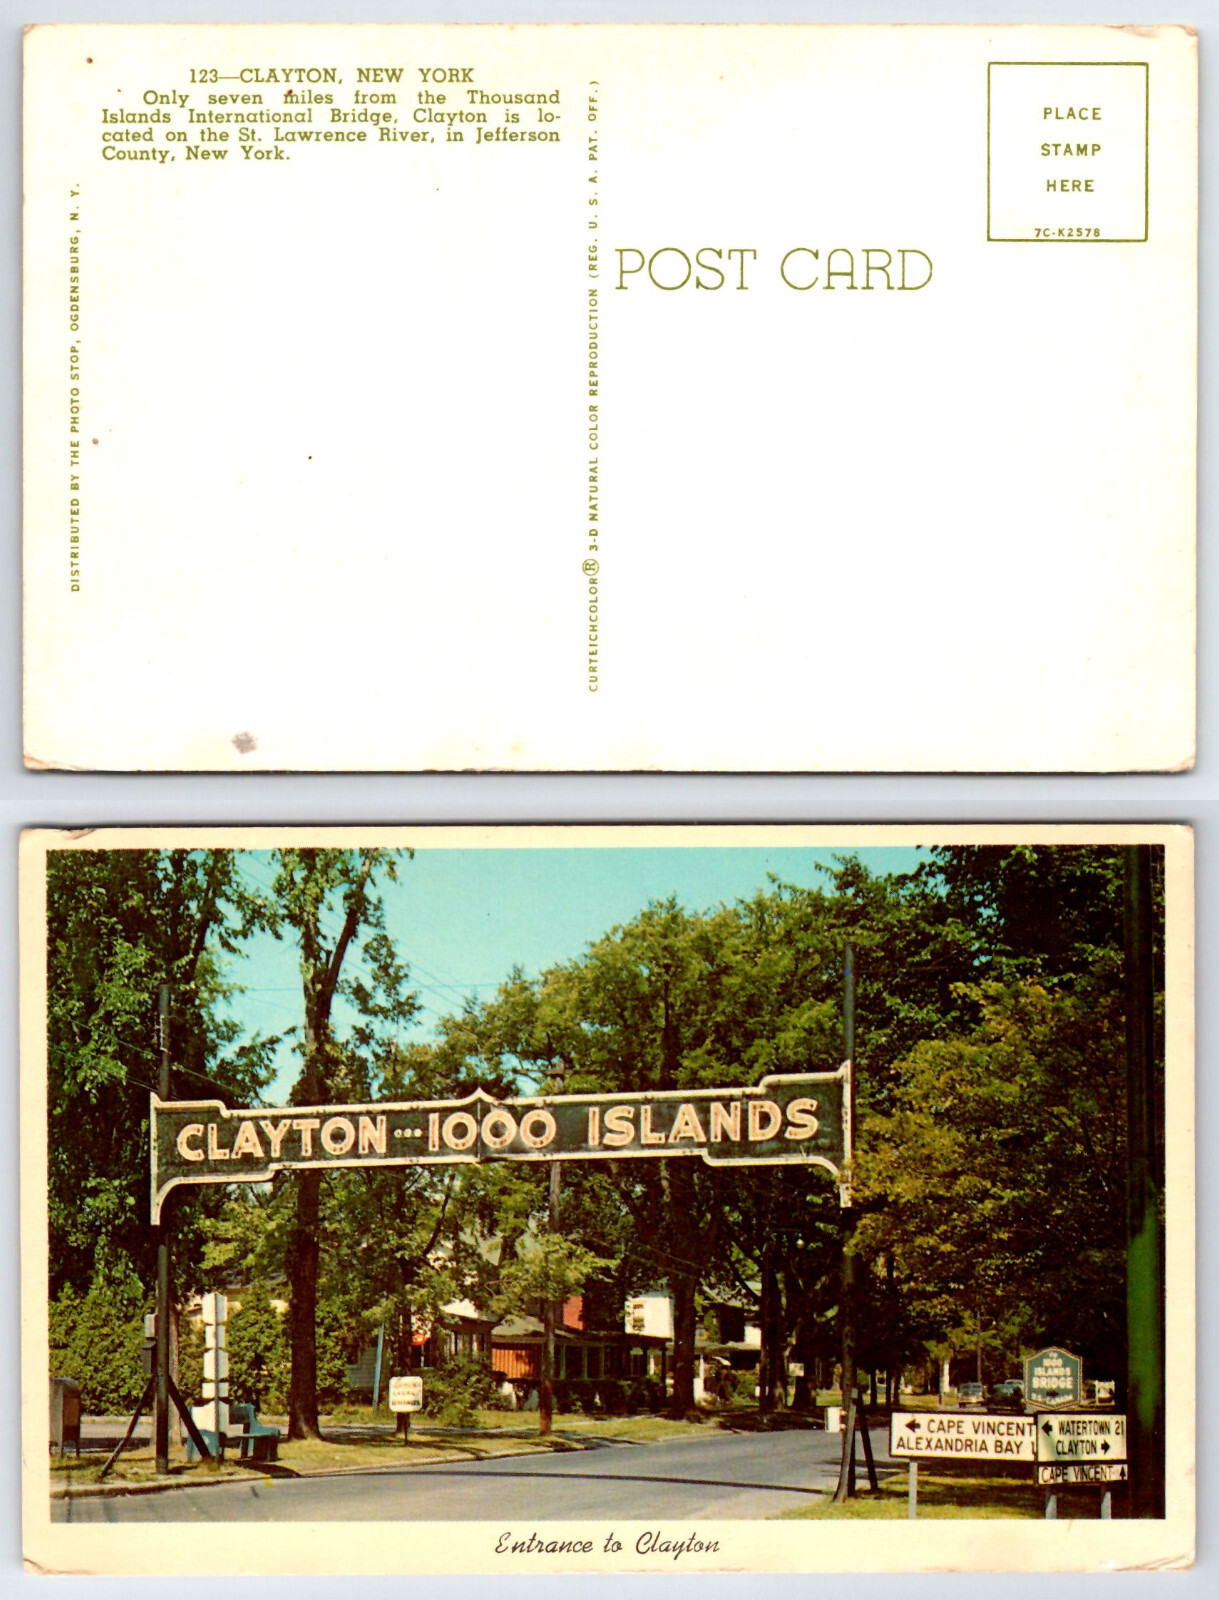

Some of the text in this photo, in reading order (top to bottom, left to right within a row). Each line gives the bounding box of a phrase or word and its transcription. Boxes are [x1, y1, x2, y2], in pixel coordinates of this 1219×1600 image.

[357, 68, 404, 84] NEW
[418, 68, 474, 84] YORK
[143, 90, 560, 107] Only seven miles from the Thousand
[587, 81, 599, 121] OFF.)
[102, 108, 560, 127] Islands International Bridge, Clayton is lo-
[1043, 107, 1102, 120] PLACE
[102, 127, 560, 144] cated on the St. Lawrence River, in Jefferson
[102, 145, 290, 163] County, New York.
[588, 131, 598, 160] PAT.
[1041, 143, 1101, 157] STAMP
[1046, 179, 1095, 192] HERE
[1034, 228, 1101, 237] 7C-K2578
[588, 240, 599, 278] (REG.
[615, 248, 933, 290] POST CARD
[70, 230, 81, 331] OGDENSBURG,
[589, 290, 598, 396] REPRODUCTION
[70, 340, 81, 380] STOP,
[70, 388, 79, 433] PHOTO
[589, 405, 598, 450] COLOR
[70, 441, 79, 466] THE
[70, 475, 79, 490] BY
[589, 458, 598, 521] NATURAL
[70, 498, 80, 592] DISTRIBUTED
[589, 529, 598, 551] 3-D
[177, 1115, 387, 1161] CLAYTON
[428, 1109, 557, 1151] 1000
[589, 1099, 818, 1147] ISLANDS
[1032, 1377, 1073, 1389] BRIDGE
[927, 1419, 1034, 1437] CAPE VINCENT
[1059, 1420, 1125, 1435] WATERTOWN 21
[896, 1436, 988, 1453] ALEXANDRIA
[994, 1440, 1023, 1455] BAY
[1056, 1440, 1097, 1455] CLAYTON
[1042, 1464, 1113, 1482] CAPE VINCENT
[495, 1530, 721, 1560] Entrance to Clayton
